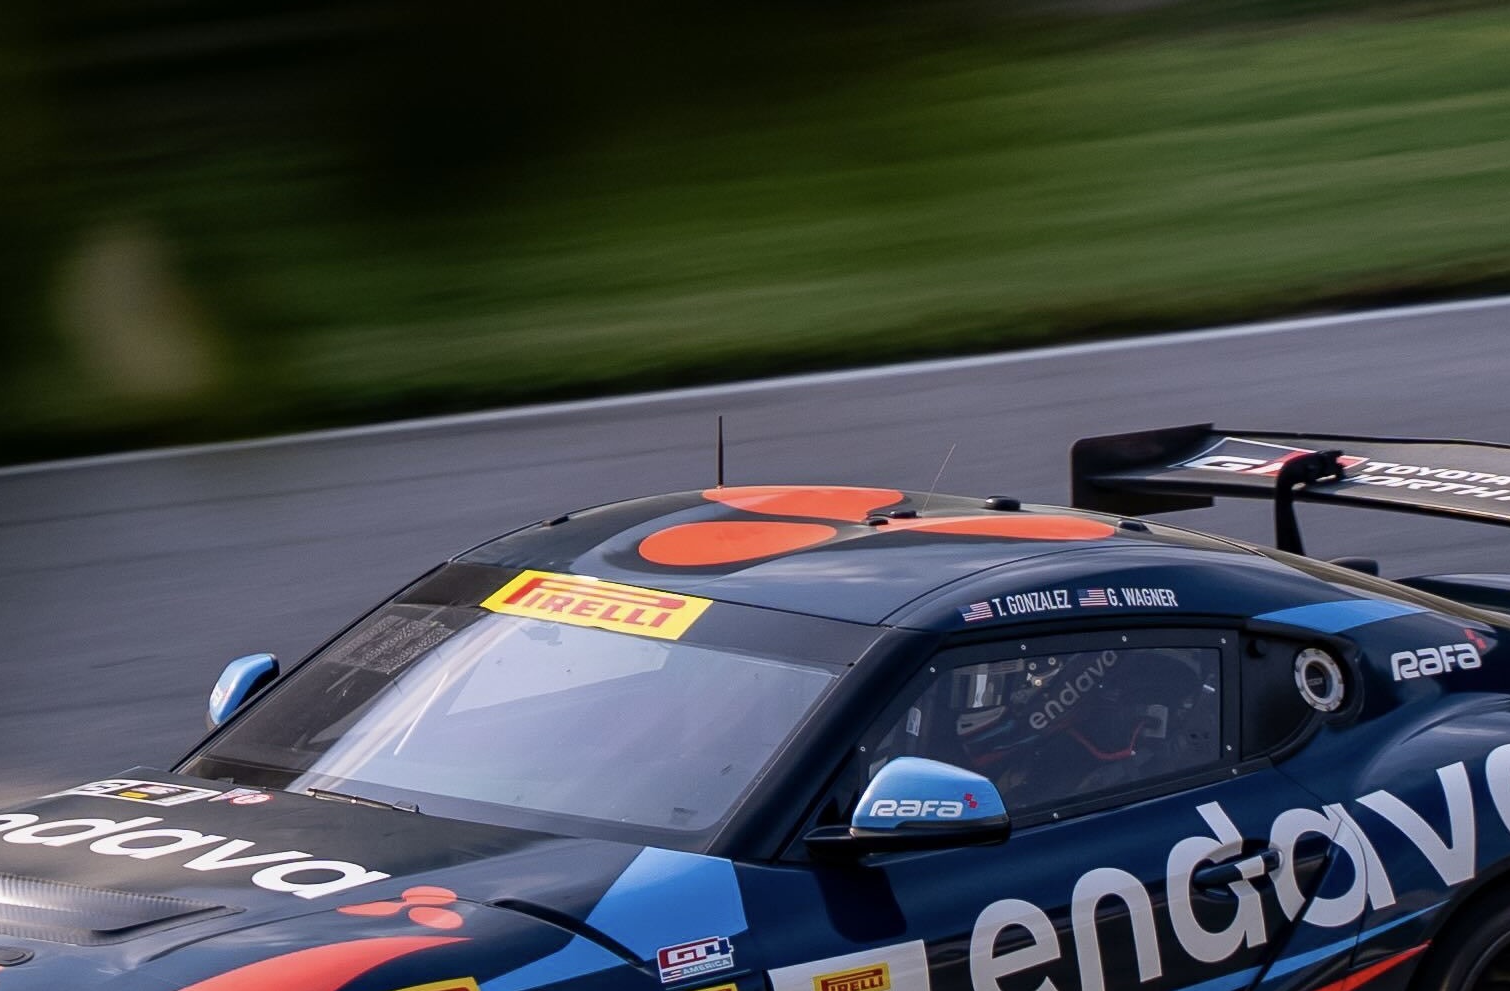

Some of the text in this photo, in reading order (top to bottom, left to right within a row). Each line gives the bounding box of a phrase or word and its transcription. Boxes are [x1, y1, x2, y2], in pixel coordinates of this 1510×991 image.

[1362, 461, 1509, 486] TOYOTA
[502, 577, 687, 628] PIRELLI
[992, 590, 1072, 616] T. GONZALEZ
[1107, 587, 1179, 607] G. WAGNER
[682, 959, 731, 975] AMERICA
